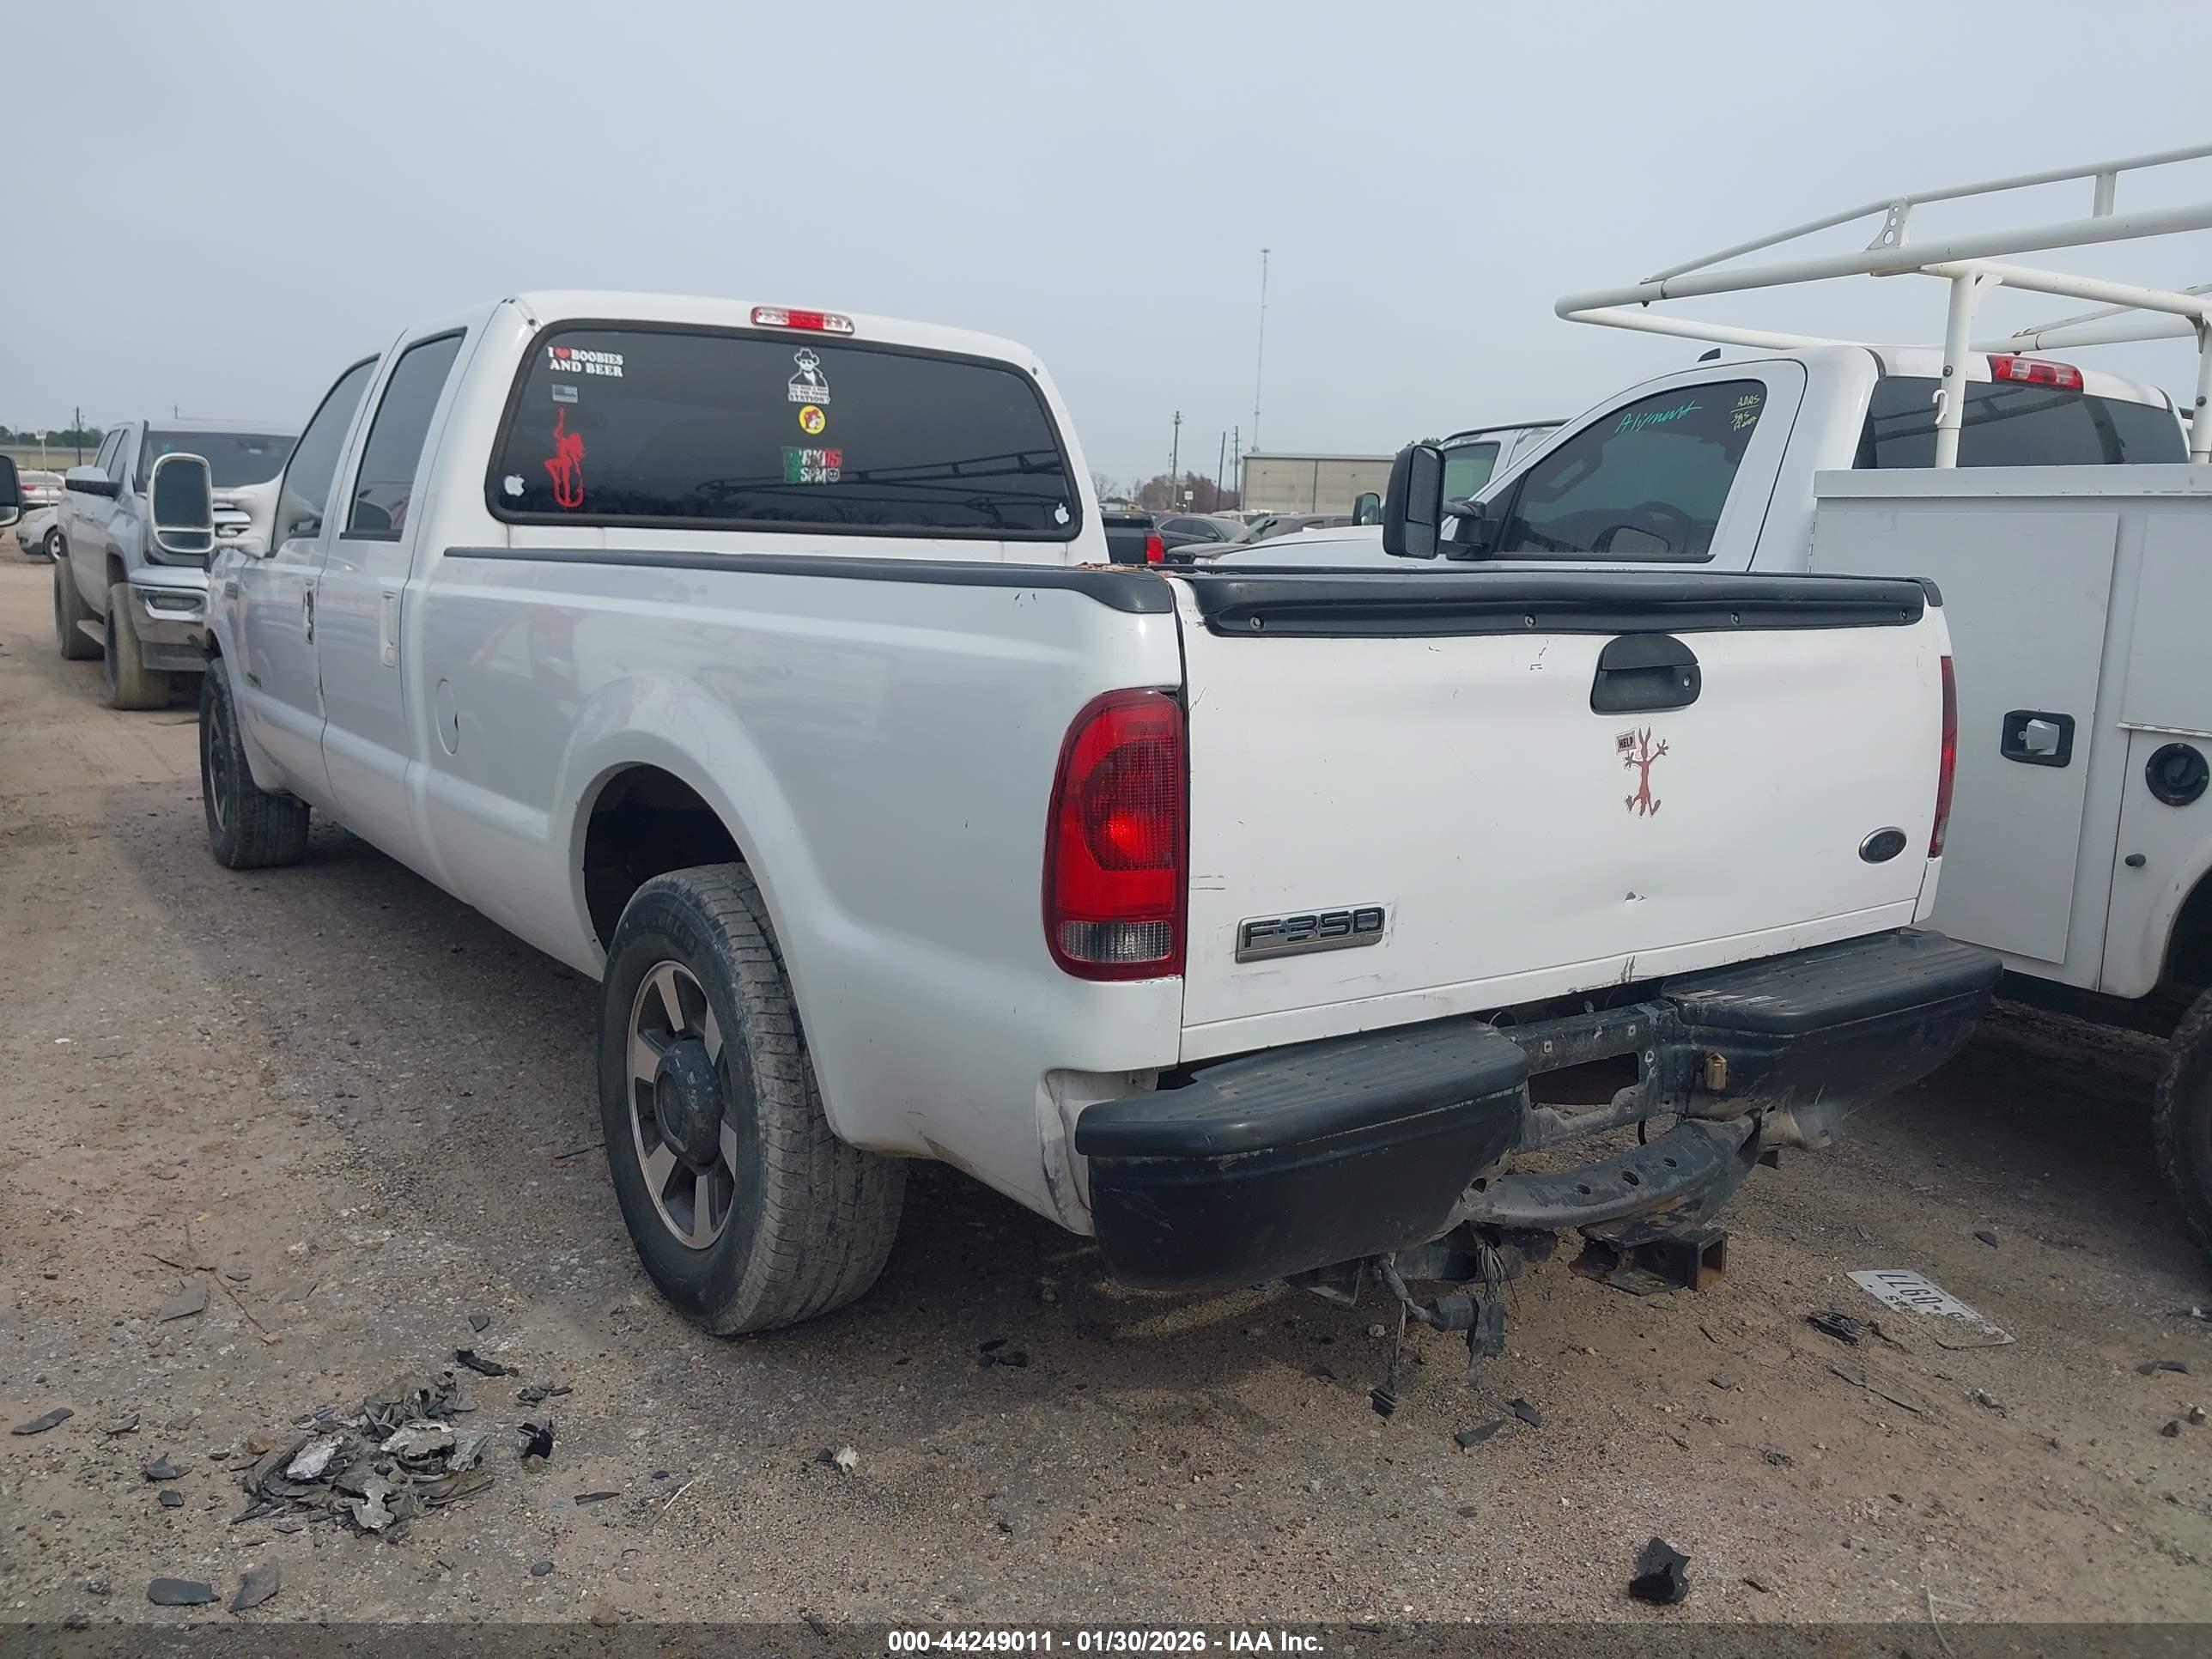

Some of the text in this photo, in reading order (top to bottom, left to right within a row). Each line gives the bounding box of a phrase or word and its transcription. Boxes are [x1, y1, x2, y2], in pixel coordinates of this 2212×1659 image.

[548, 346, 623, 365] I BOOBIES
[550, 359, 623, 377] AND BEER
[1737, 394, 1760, 407] ADAS
[1618, 736, 1634, 749] HELP
[1244, 907, 1385, 948] F-350
